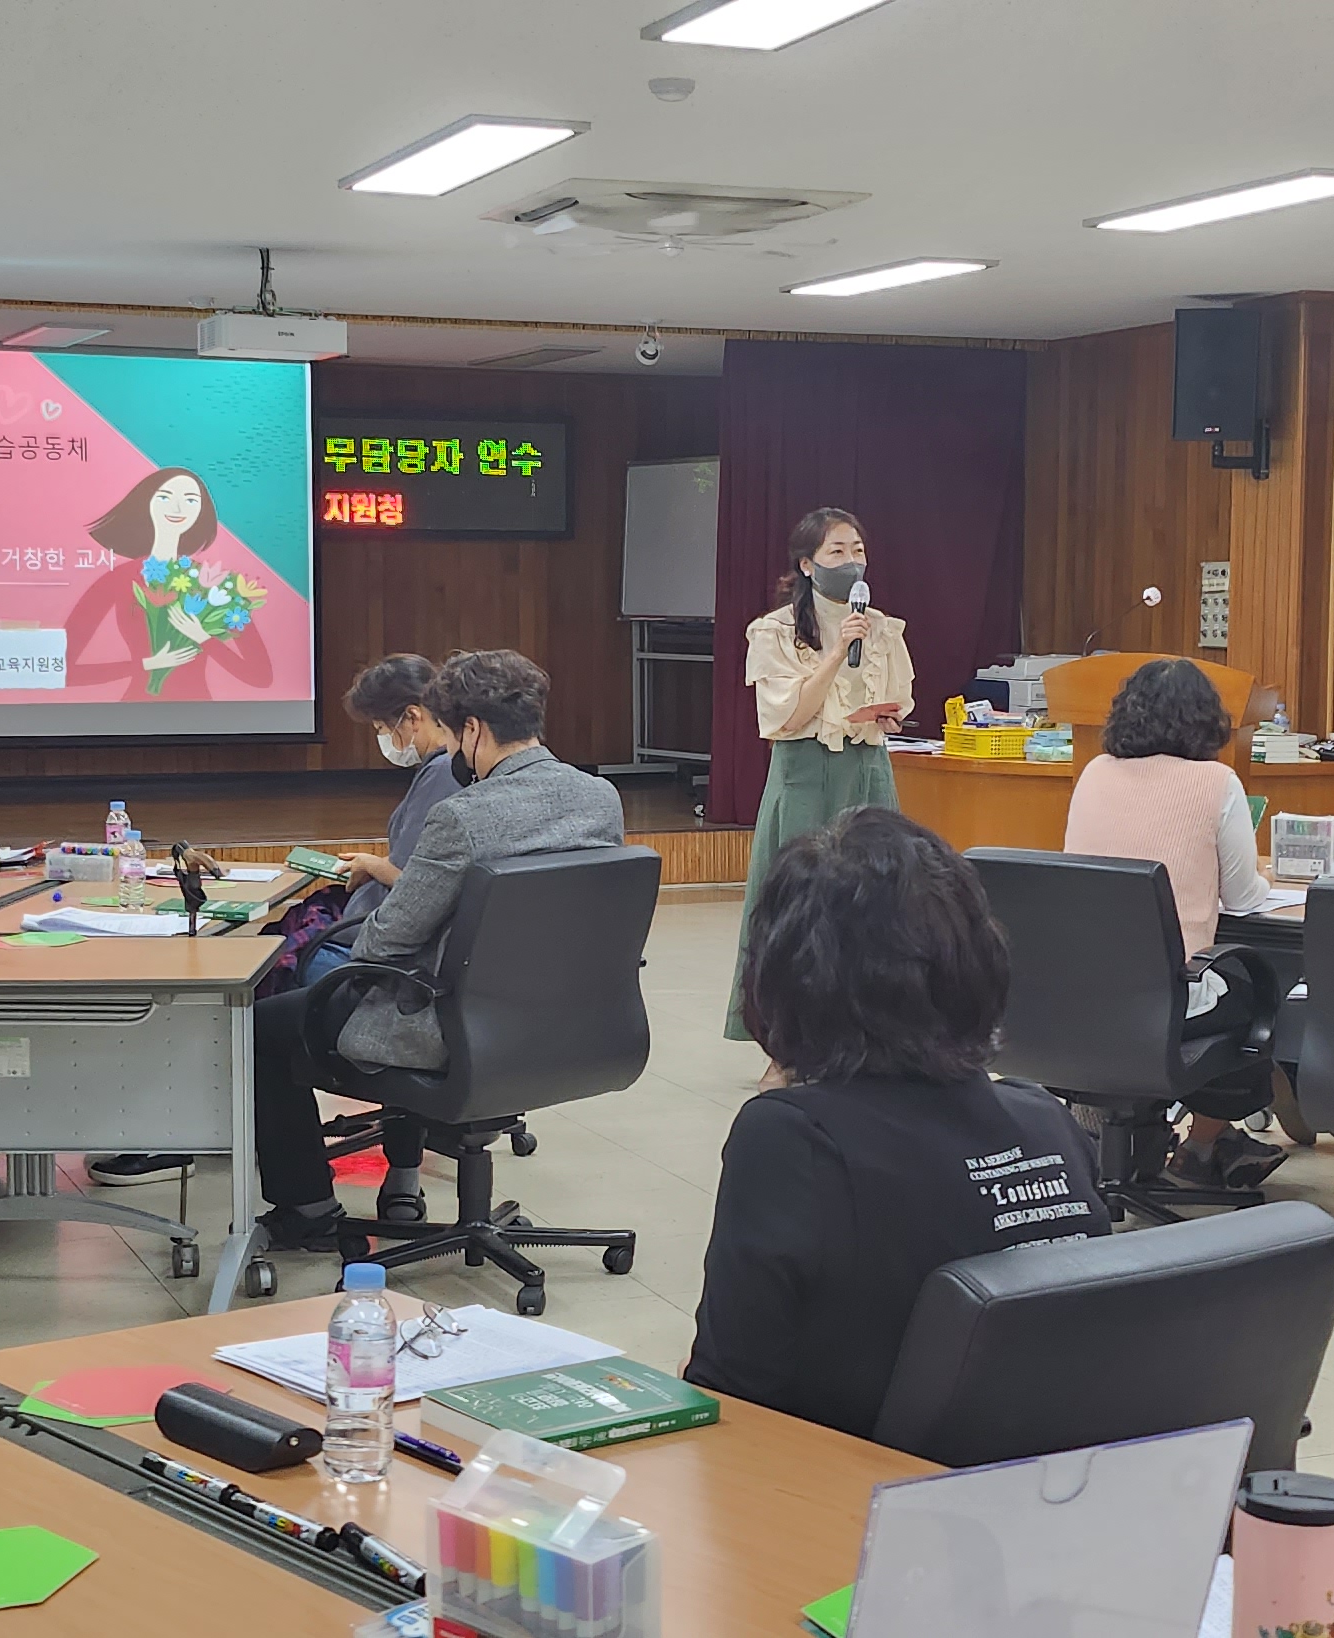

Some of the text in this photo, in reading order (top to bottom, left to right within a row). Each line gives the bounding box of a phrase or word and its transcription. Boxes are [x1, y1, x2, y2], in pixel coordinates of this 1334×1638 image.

[324, 437, 543, 477] 무담당자 연수
[323, 491, 405, 526] 지원청
[0, 547, 68, 573] 거창한
[74, 547, 117, 573] 교사
